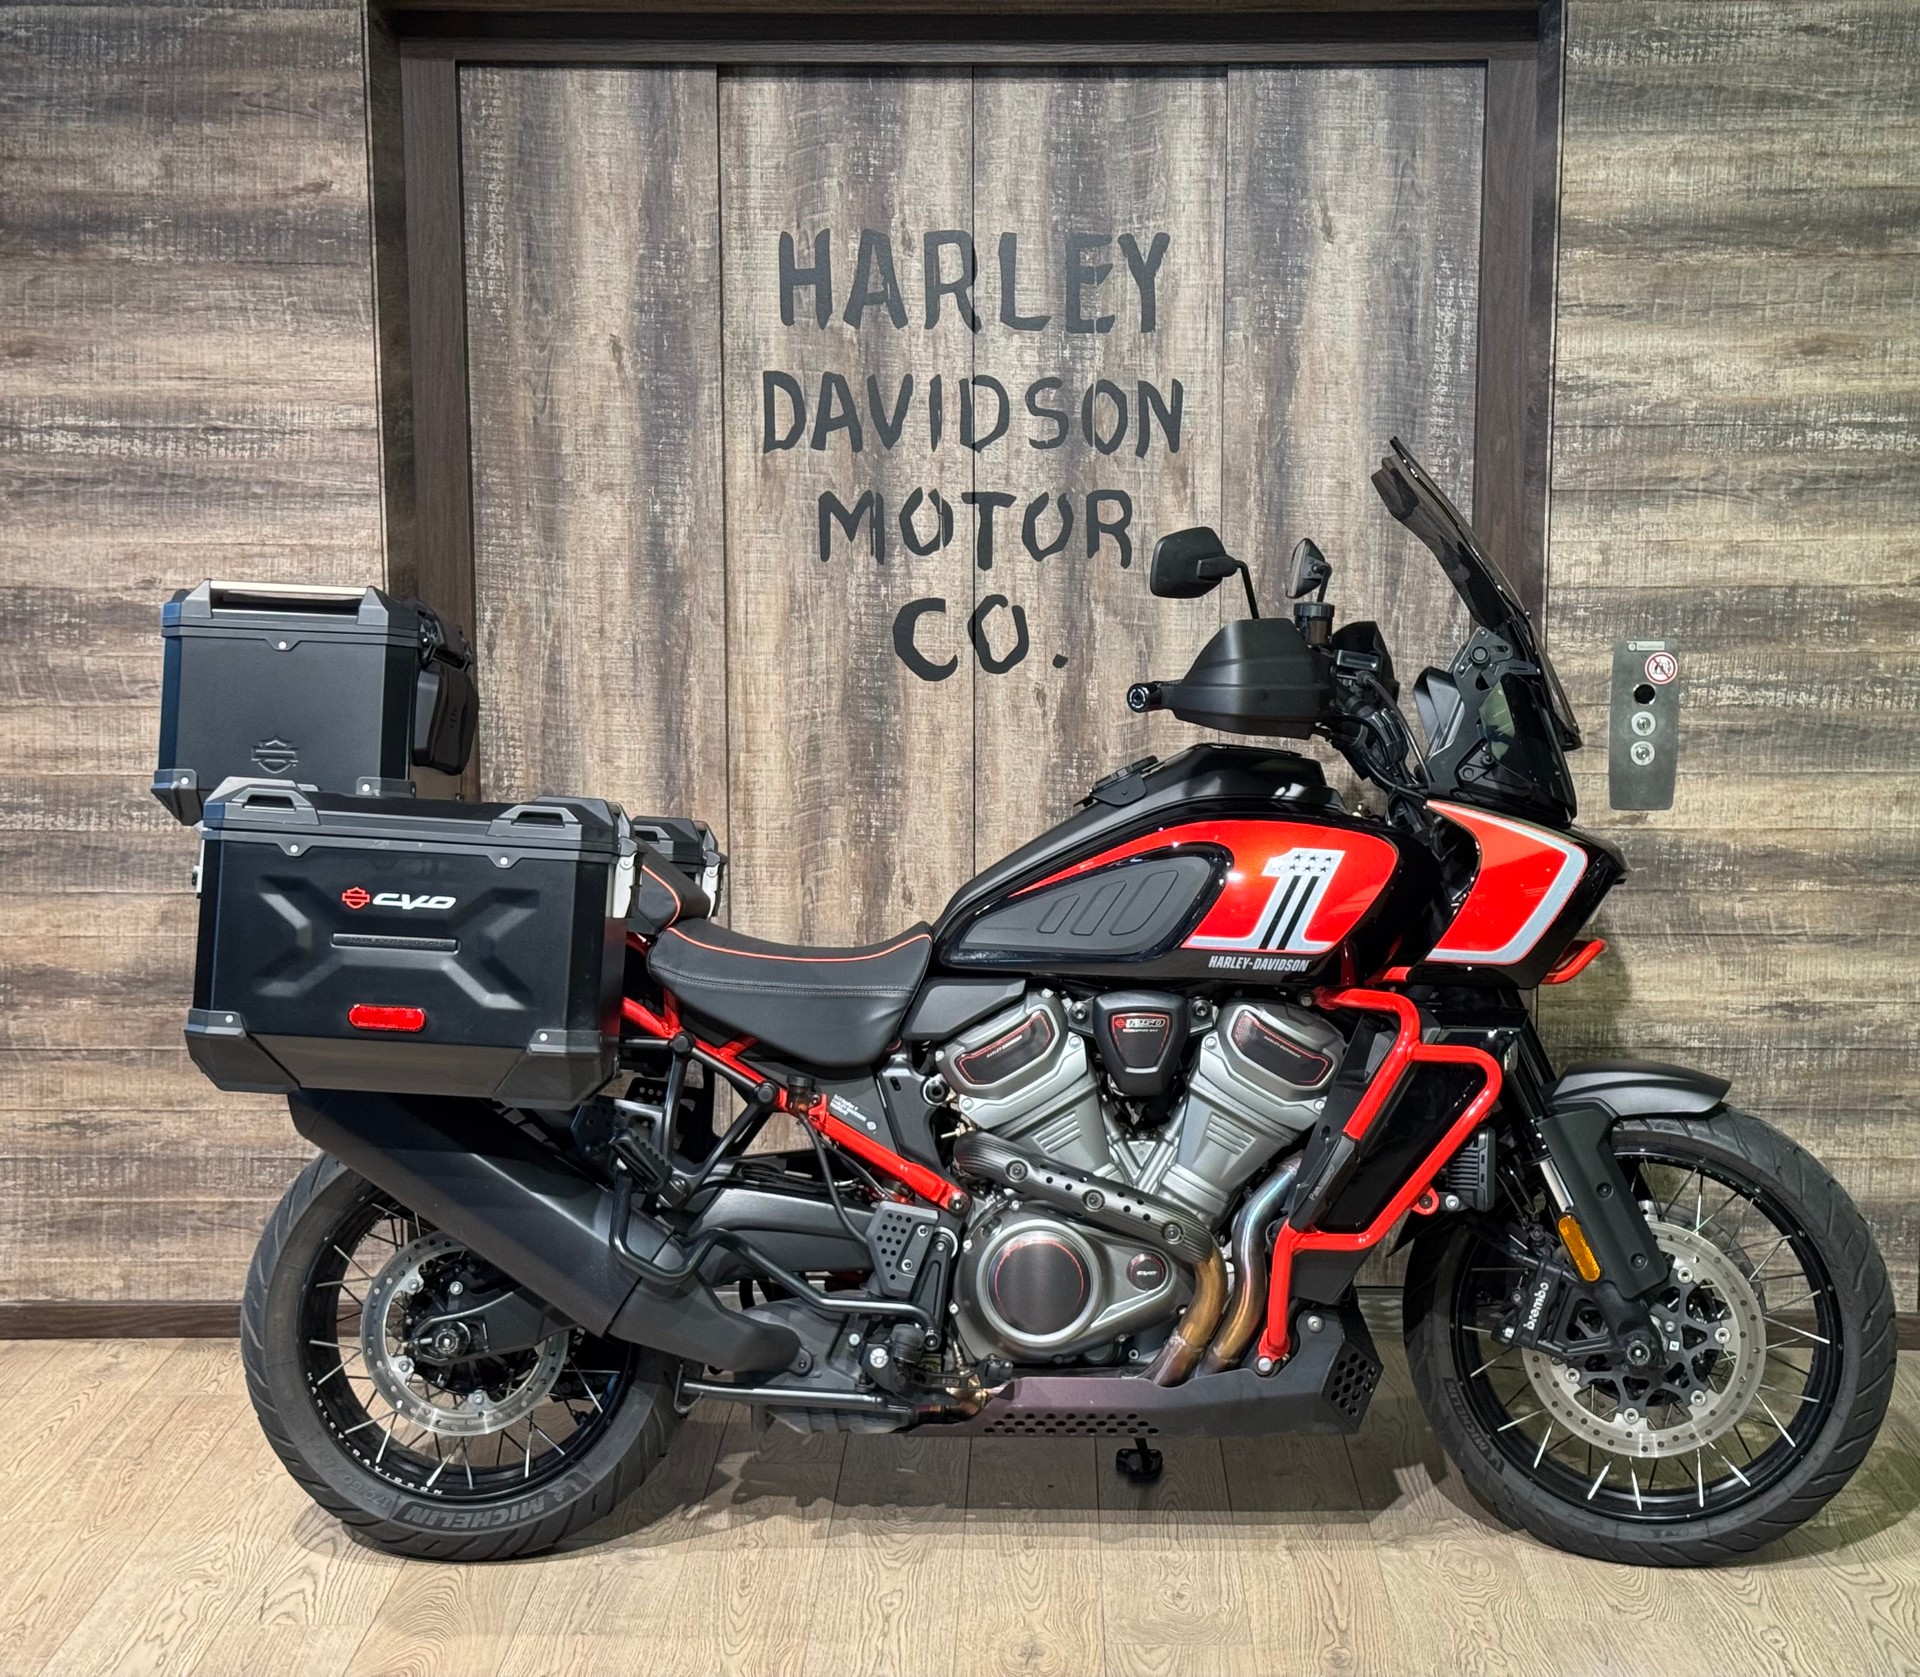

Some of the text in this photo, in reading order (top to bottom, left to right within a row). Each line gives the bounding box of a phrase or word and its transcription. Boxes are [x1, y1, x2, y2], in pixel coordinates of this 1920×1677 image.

[778, 228, 1171, 334] HARLEY
[763, 370, 1184, 458] DAVIDSON
[817, 487, 1133, 571] MOTOR
[892, 594, 1069, 681] CO.
[372, 892, 457, 910] CVO
[1208, 955, 1310, 972] HARLEY-DAVIDSON
[1522, 1281, 1549, 1331] brembo
[1444, 1381, 1489, 1452] MICHELIN
[403, 1493, 546, 1529] MICHELIN
